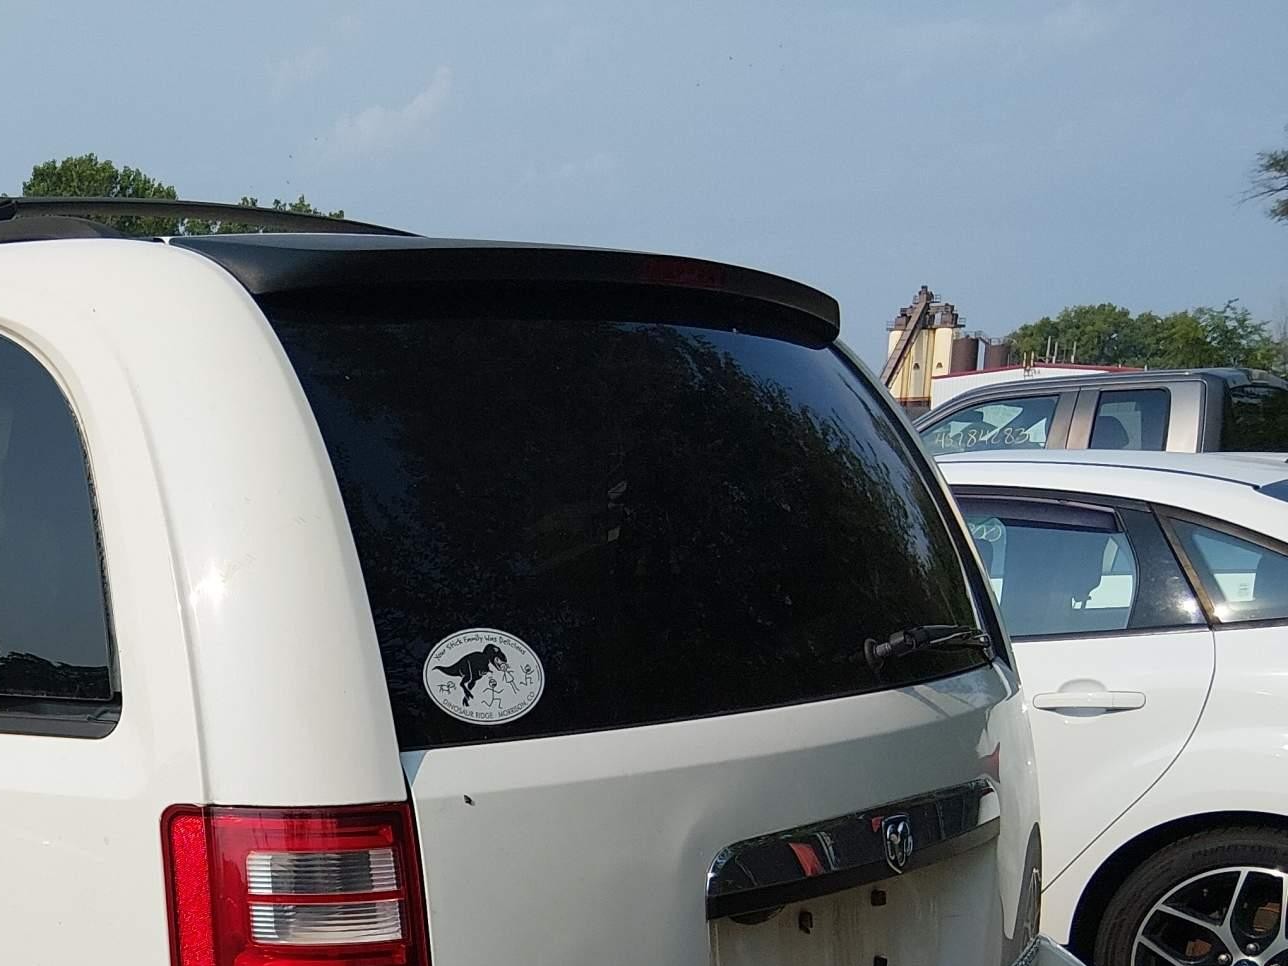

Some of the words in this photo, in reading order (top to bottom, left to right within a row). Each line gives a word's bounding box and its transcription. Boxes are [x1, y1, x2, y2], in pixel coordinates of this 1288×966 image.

[434, 650, 446, 661] Your
[446, 639, 463, 650] Stick
[463, 634, 483, 644] Family
[498, 636, 526, 655] Delicious
[443, 699, 474, 717] DINOSAUR
[475, 711, 494, 719] RIDGE
[527, 692, 535, 702] CO
